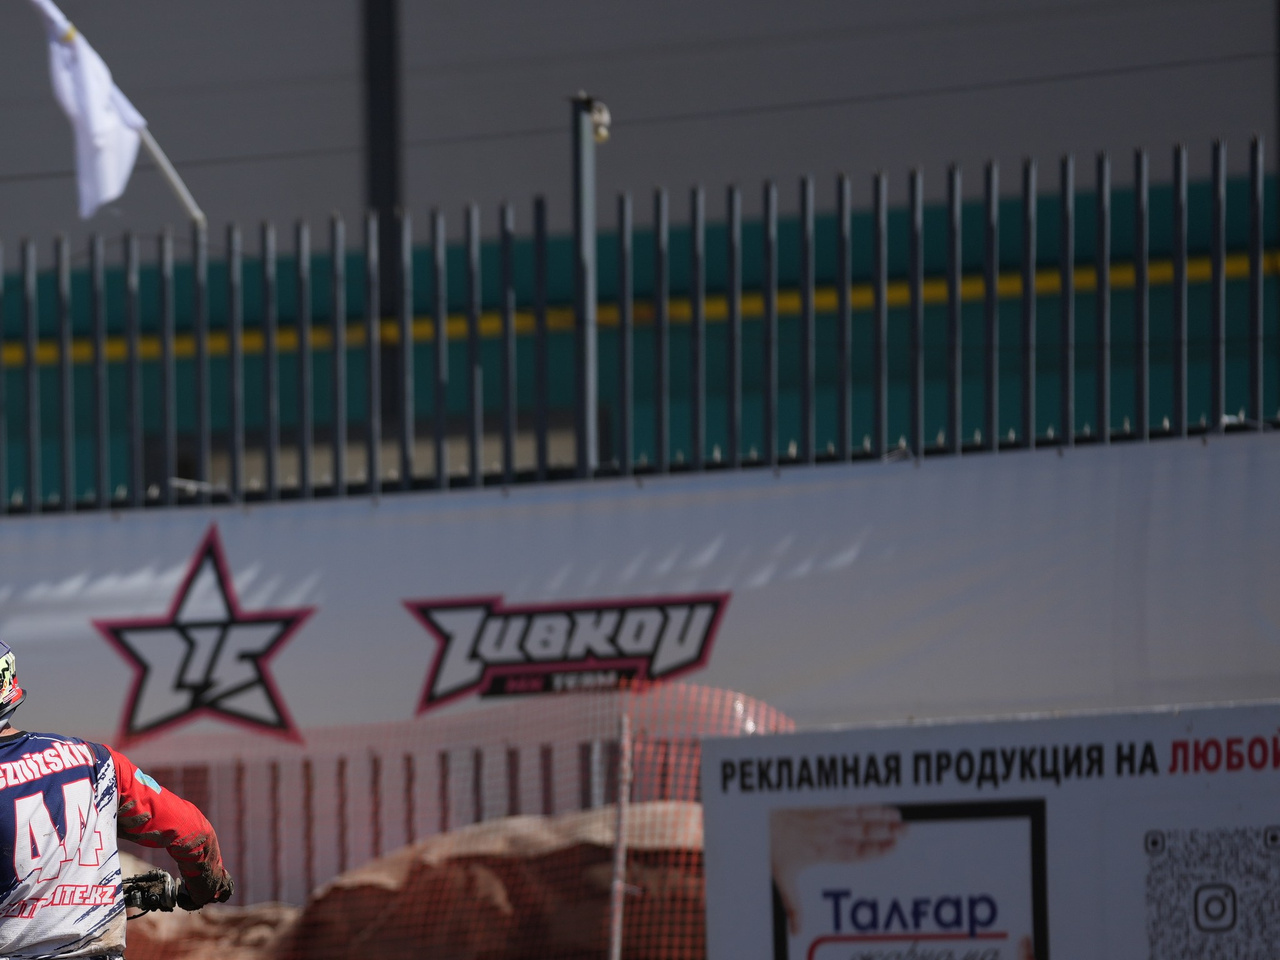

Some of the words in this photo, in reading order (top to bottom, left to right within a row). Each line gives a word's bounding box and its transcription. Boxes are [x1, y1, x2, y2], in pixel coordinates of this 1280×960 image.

[721, 752, 902, 794] РЕКЛАМНАЯ
[913, 742, 1105, 789] ПРОДУКЦИЯ
[1115, 741, 1160, 777] НА
[13, 777, 103, 883] 44
